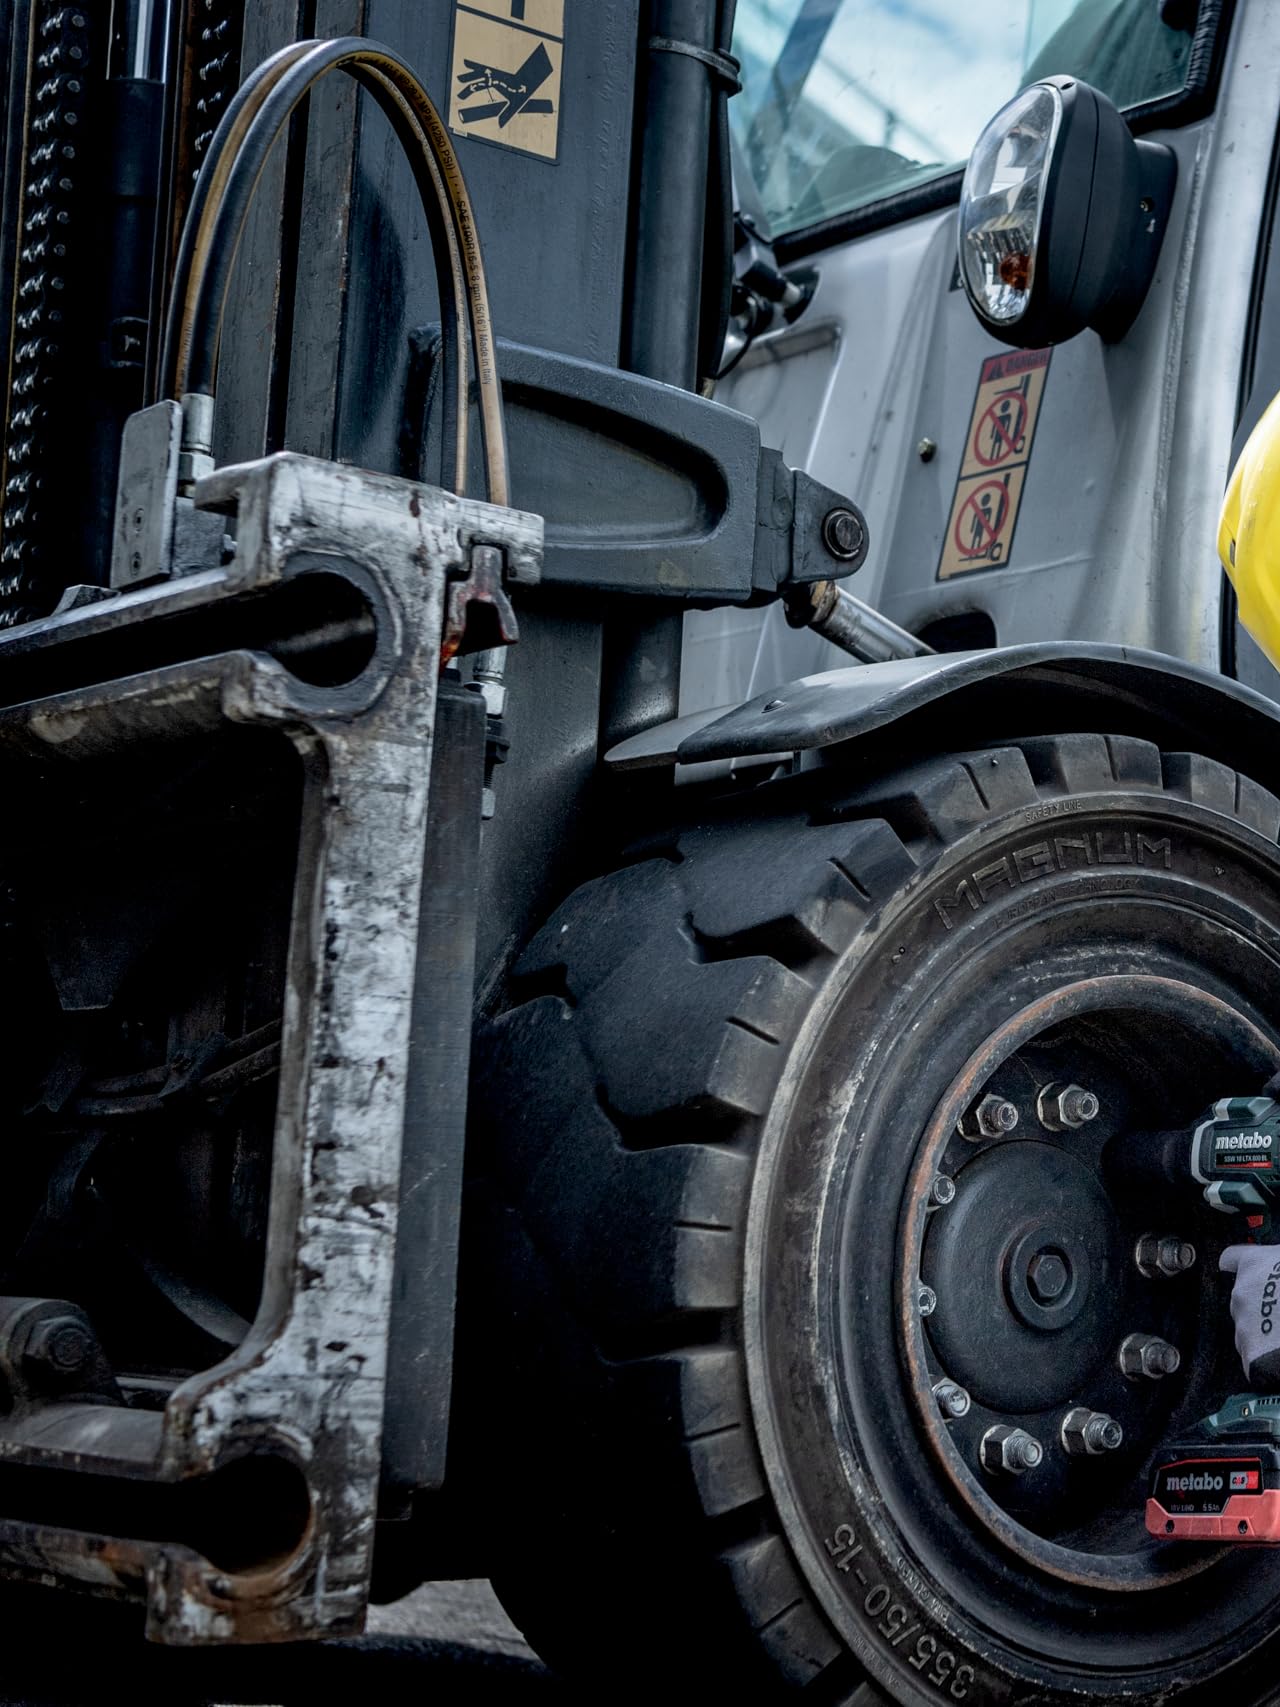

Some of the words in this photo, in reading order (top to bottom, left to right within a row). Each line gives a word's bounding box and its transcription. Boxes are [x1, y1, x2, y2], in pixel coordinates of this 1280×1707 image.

[478, 333, 490, 357] Made
[1025, 802, 1060, 822] SAFETY
[1063, 799, 1082, 812] LINE
[932, 831, 1173, 930] MAGNUM
[1215, 1131, 1273, 1150] metabo
[1166, 1472, 1223, 1491] metabo
